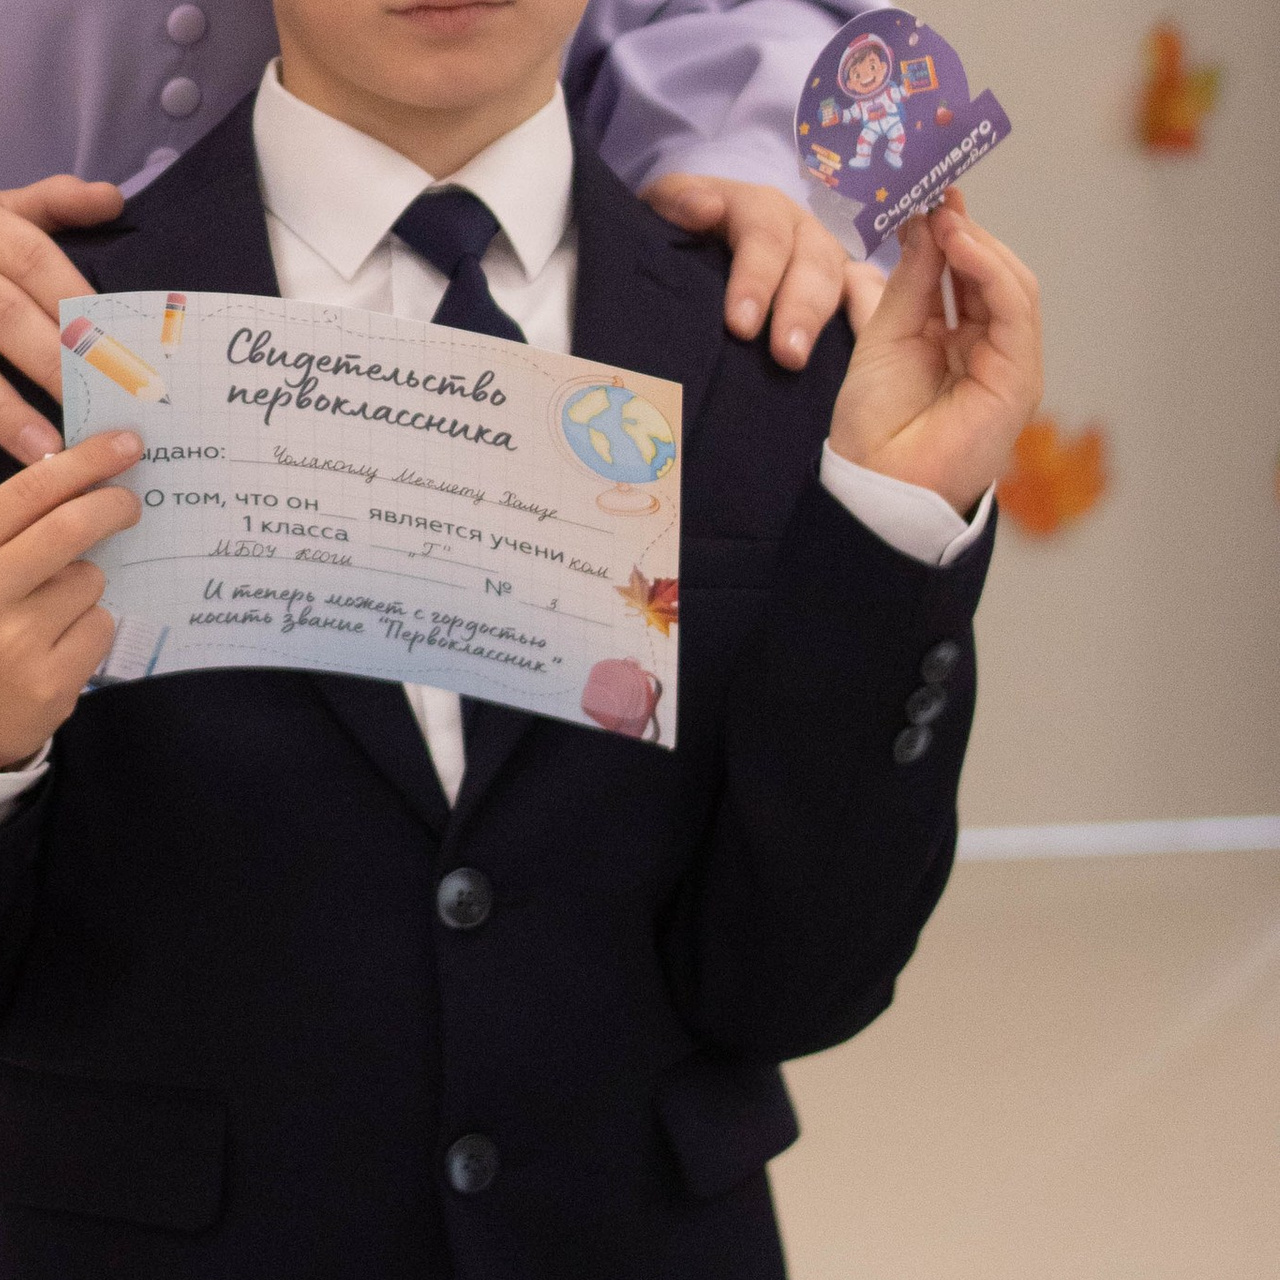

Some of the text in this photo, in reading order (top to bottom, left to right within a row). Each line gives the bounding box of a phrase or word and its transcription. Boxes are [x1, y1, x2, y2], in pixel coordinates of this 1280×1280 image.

[873, 119, 992, 232] Счастливого
[227, 327, 508, 407] Свидетельство
[227, 376, 519, 452] первоклассника
[140, 445, 227, 464] ыдано:
[144, 488, 166, 507] О
[172, 490, 227, 508] том,
[234, 492, 279, 508] что
[286, 495, 320, 512] он
[369, 507, 483, 543] является
[242, 515, 350, 542] 1 класса
[203, 578, 547, 650] И теперь может с гордостью
[485, 577, 513, 597] №
[188, 609, 274, 626] носить
[280, 605, 366, 634] звание
